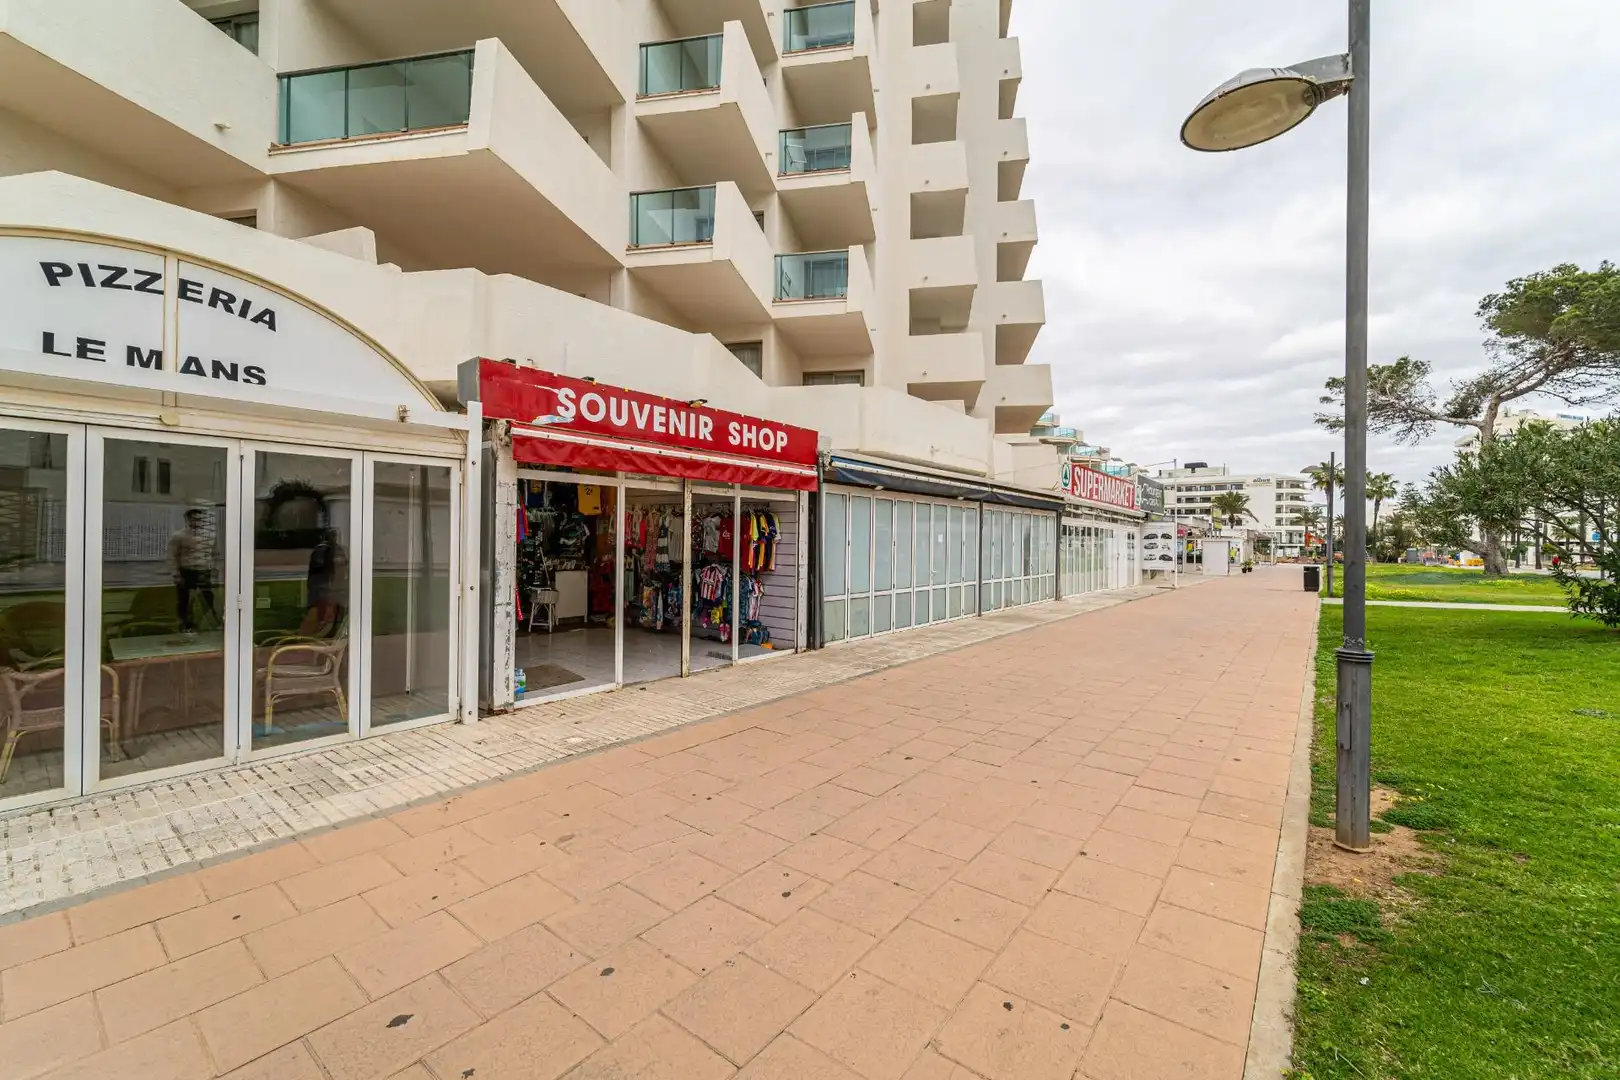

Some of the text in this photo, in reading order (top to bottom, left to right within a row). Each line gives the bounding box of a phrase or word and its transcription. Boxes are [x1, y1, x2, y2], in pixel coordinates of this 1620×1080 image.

[39, 261, 278, 332] PIZZERIA
[41, 331, 268, 386] LE MANS
[556, 387, 789, 453] SOUVENIR SHOP
[1074, 466, 1134, 507] SUPERMARKET
